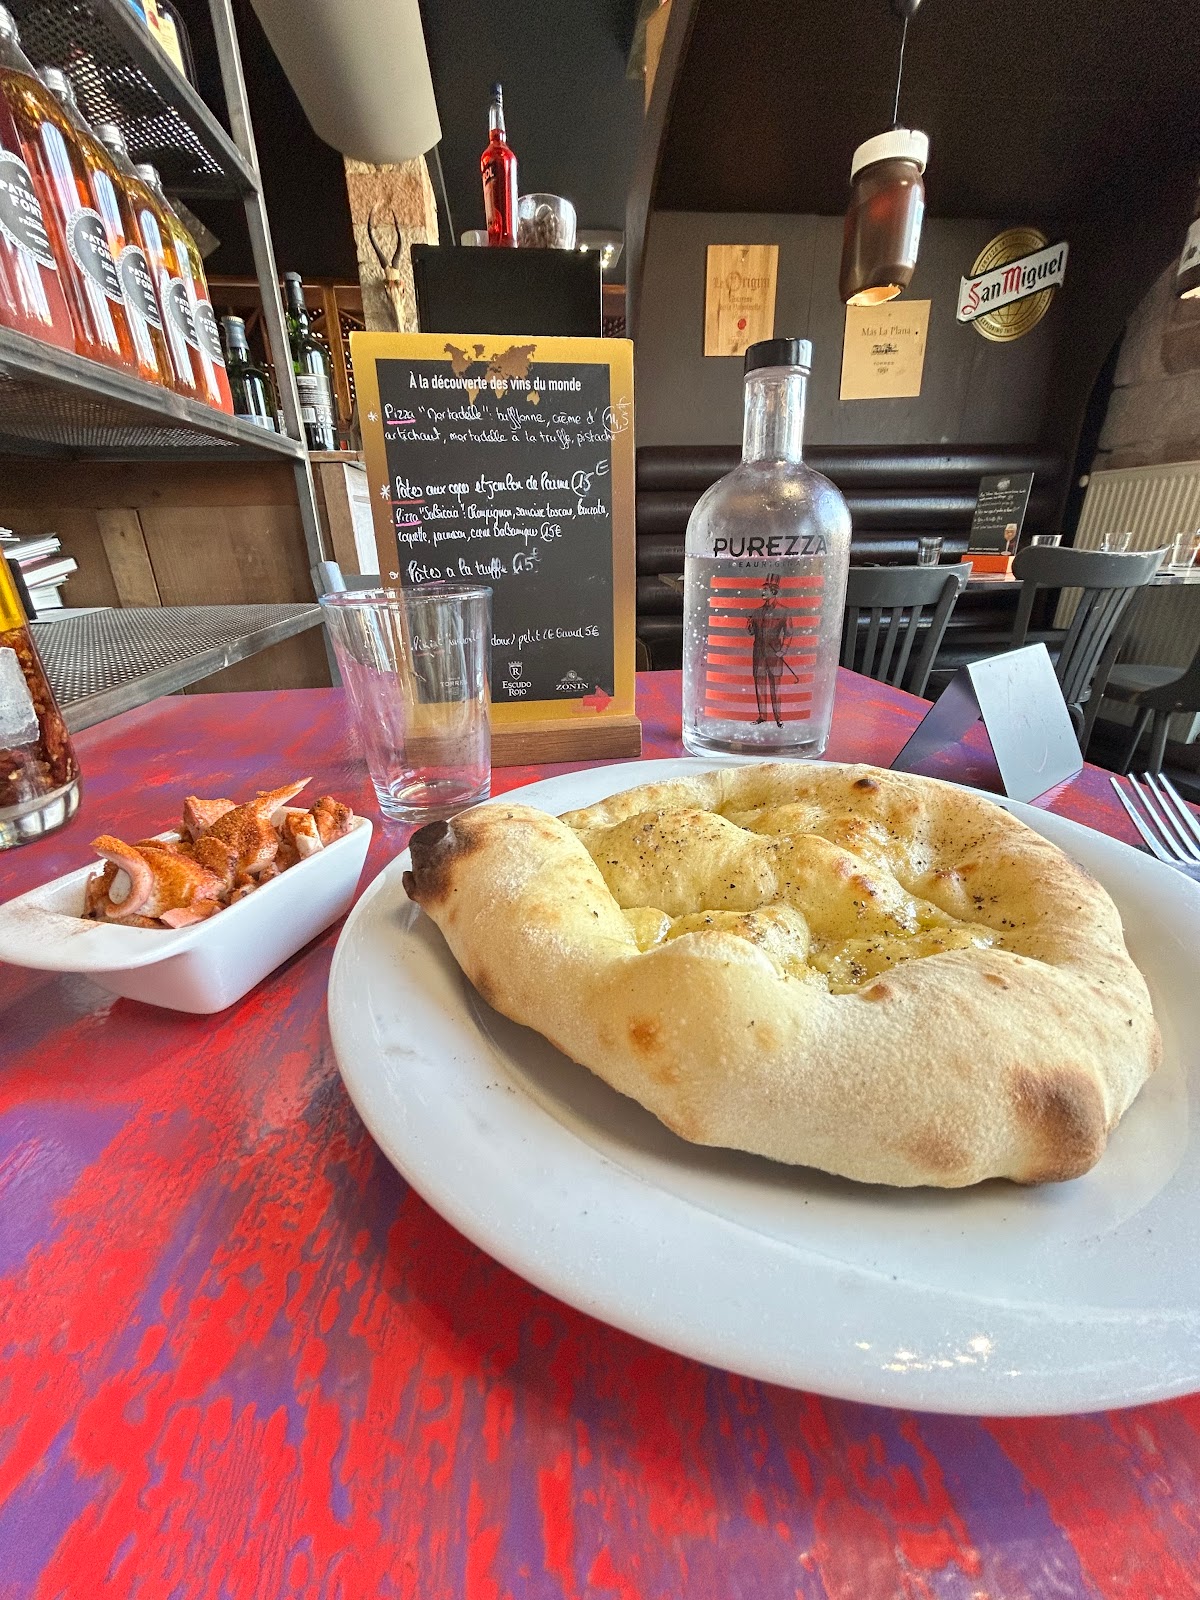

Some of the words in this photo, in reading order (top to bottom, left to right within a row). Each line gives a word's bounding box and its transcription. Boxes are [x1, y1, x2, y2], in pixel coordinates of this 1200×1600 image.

[861, 327, 877, 336] Mas
[879, 327, 888, 336] La
[890, 326, 911, 336] Plana
[409, 370, 418, 389] À
[419, 374, 429, 389] la
[431, 374, 488, 390] découverte
[490, 375, 508, 390] des
[510, 376, 531, 391] vins
[533, 376, 546, 391] du
[548, 377, 582, 392] monde
[384, 403, 415, 419] Pizza
[525, 431, 538, 443] la
[525, 474, 539, 490] de
[713, 534, 828, 558] PUREZZA
[458, 557, 474, 577] la
[555, 682, 590, 692] ZONIN
